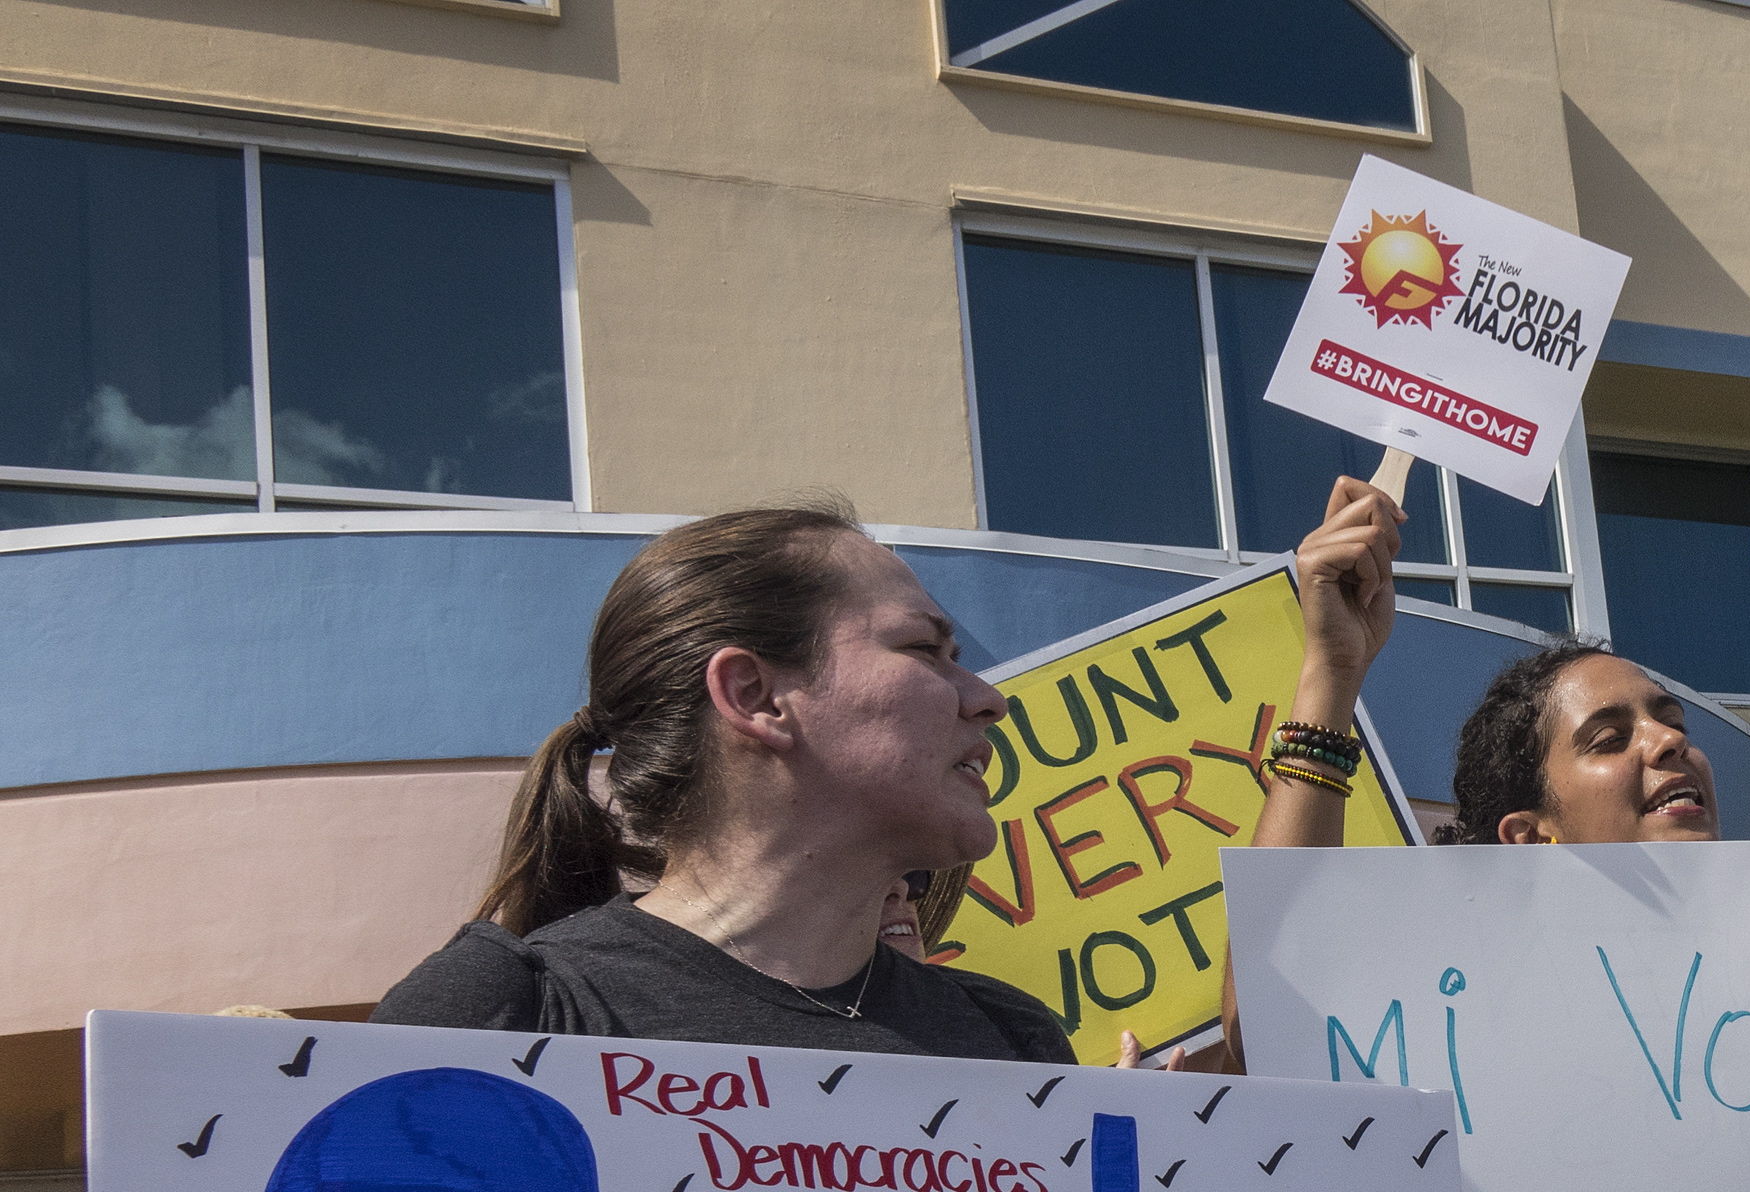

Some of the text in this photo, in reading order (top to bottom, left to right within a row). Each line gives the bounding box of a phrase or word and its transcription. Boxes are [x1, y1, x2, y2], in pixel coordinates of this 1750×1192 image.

[1467, 269, 1583, 341] FLORIDA
[1478, 254, 1522, 278] The New
[1454, 296, 1587, 371] MAJORITY
[1317, 348, 1532, 449] #BRINGITHOME
[983, 609, 1228, 808] OUNT
[925, 702, 1277, 964] VERY
[1043, 881, 1225, 1037] VOT
[601, 1051, 769, 1117] Real
